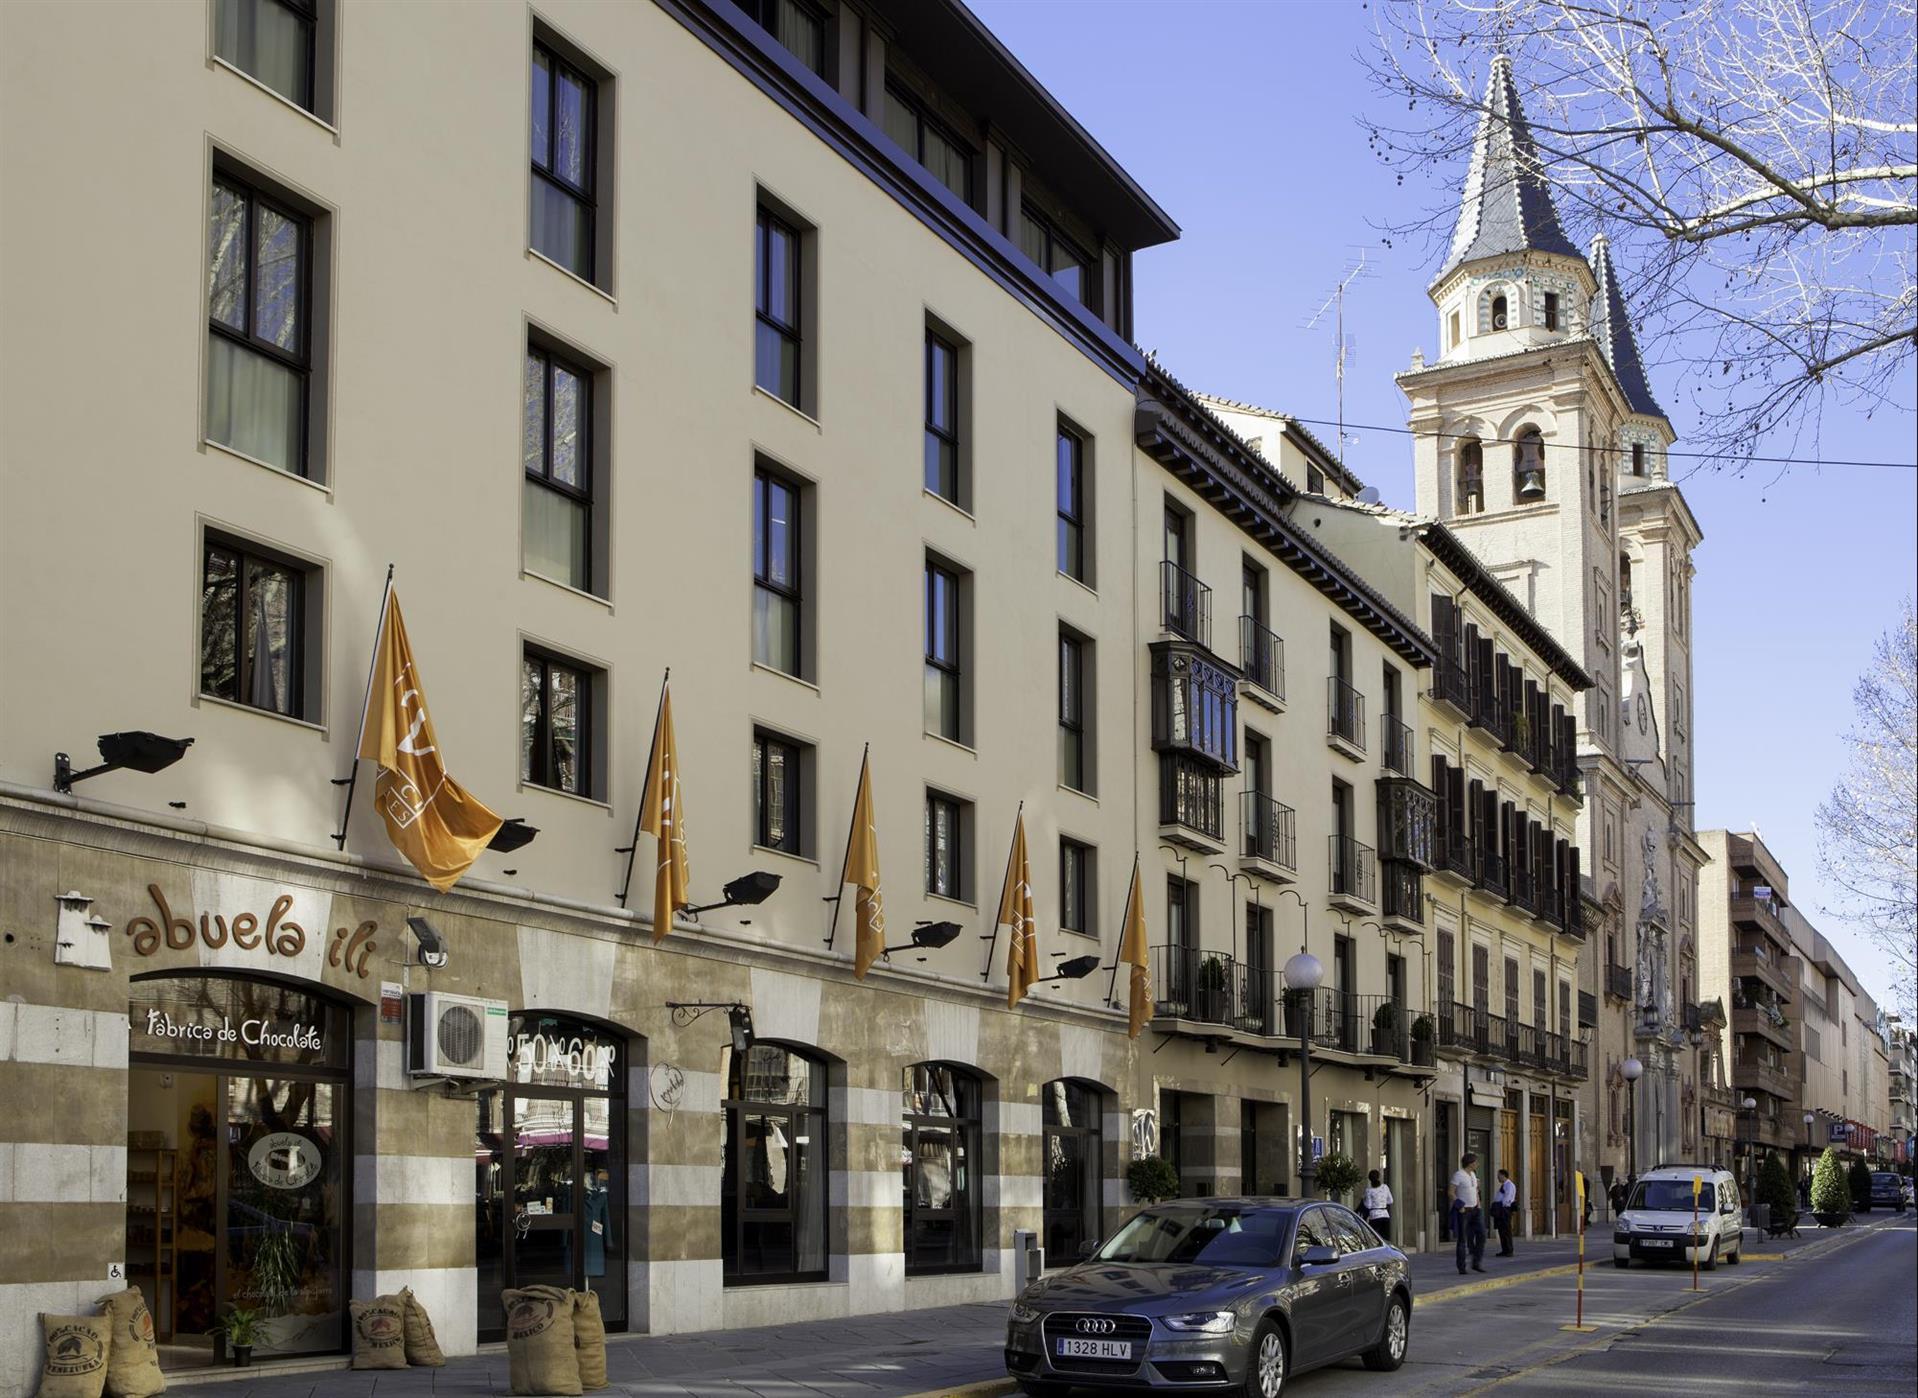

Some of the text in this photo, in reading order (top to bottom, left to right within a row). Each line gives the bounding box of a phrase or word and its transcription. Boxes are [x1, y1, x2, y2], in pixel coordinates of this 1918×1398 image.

[126, 883, 379, 979] abuela ili
[217, 1016, 237, 1042] de
[240, 1019, 322, 1050] Chocolate
[1834, 1125, 1843, 1135] P
[1067, 1340, 1127, 1357] 1328 HLV
